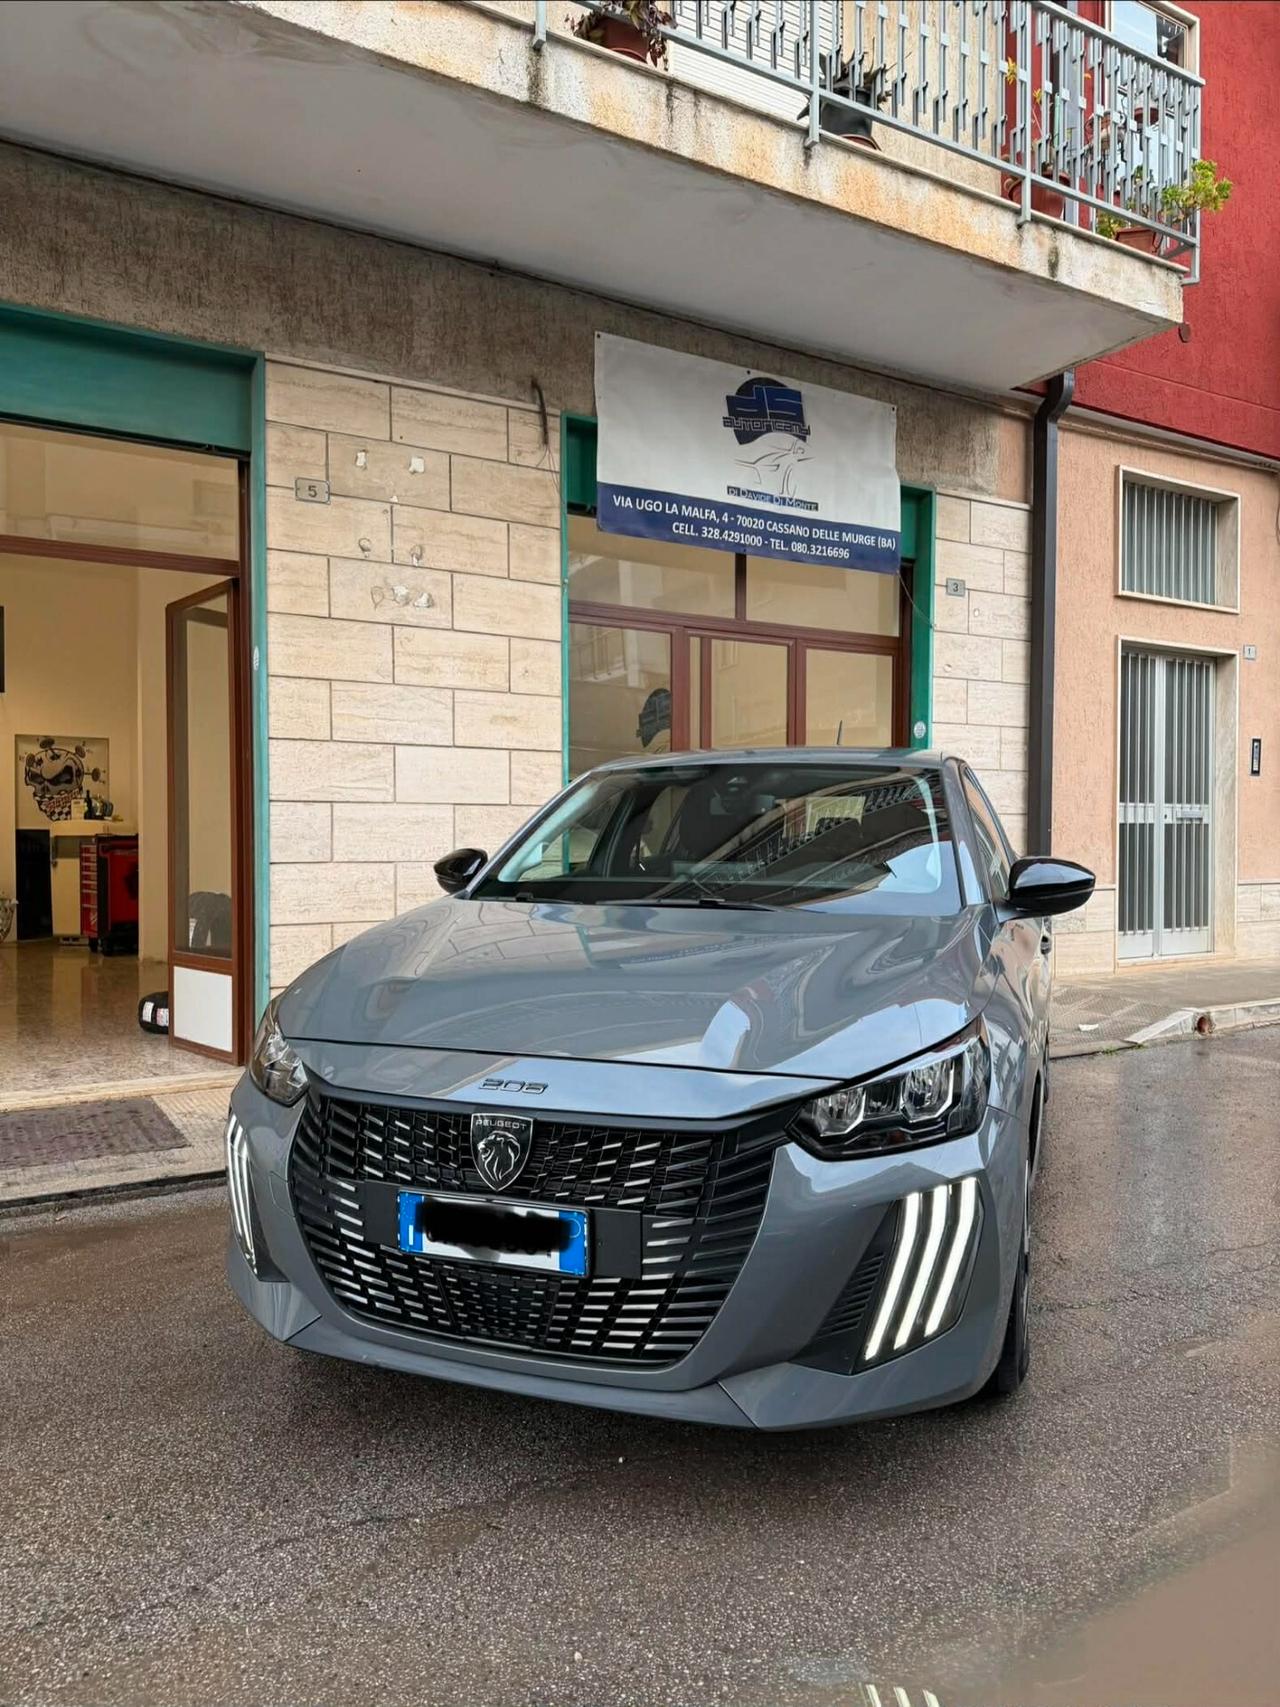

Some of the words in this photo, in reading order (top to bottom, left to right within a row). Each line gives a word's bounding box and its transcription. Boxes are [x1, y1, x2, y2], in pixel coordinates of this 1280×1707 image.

[308, 485, 318, 498] 5
[785, 497, 817, 511] MONTE
[613, 494, 633, 508] VIA
[636, 498, 662, 512] UGO
[665, 502, 679, 515] LA
[681, 505, 720, 523] MALFA,
[722, 512, 729, 523] 4
[736, 514, 765, 530] 70020
[766, 520, 809, 537] CASSANO
[812, 528, 839, 541] DELLE
[842, 532, 876, 546] MURGE
[877, 537, 896, 551] (BA)
[672, 522, 698, 537] CELL.
[701, 527, 763, 546] 328.4291000
[769, 538, 789, 551] TEL.
[791, 541, 850, 559] 080.3216696
[953, 582, 959, 592] 3
[478, 1078, 549, 1094] 208
[475, 1119, 527, 1131] PEUGEOT
